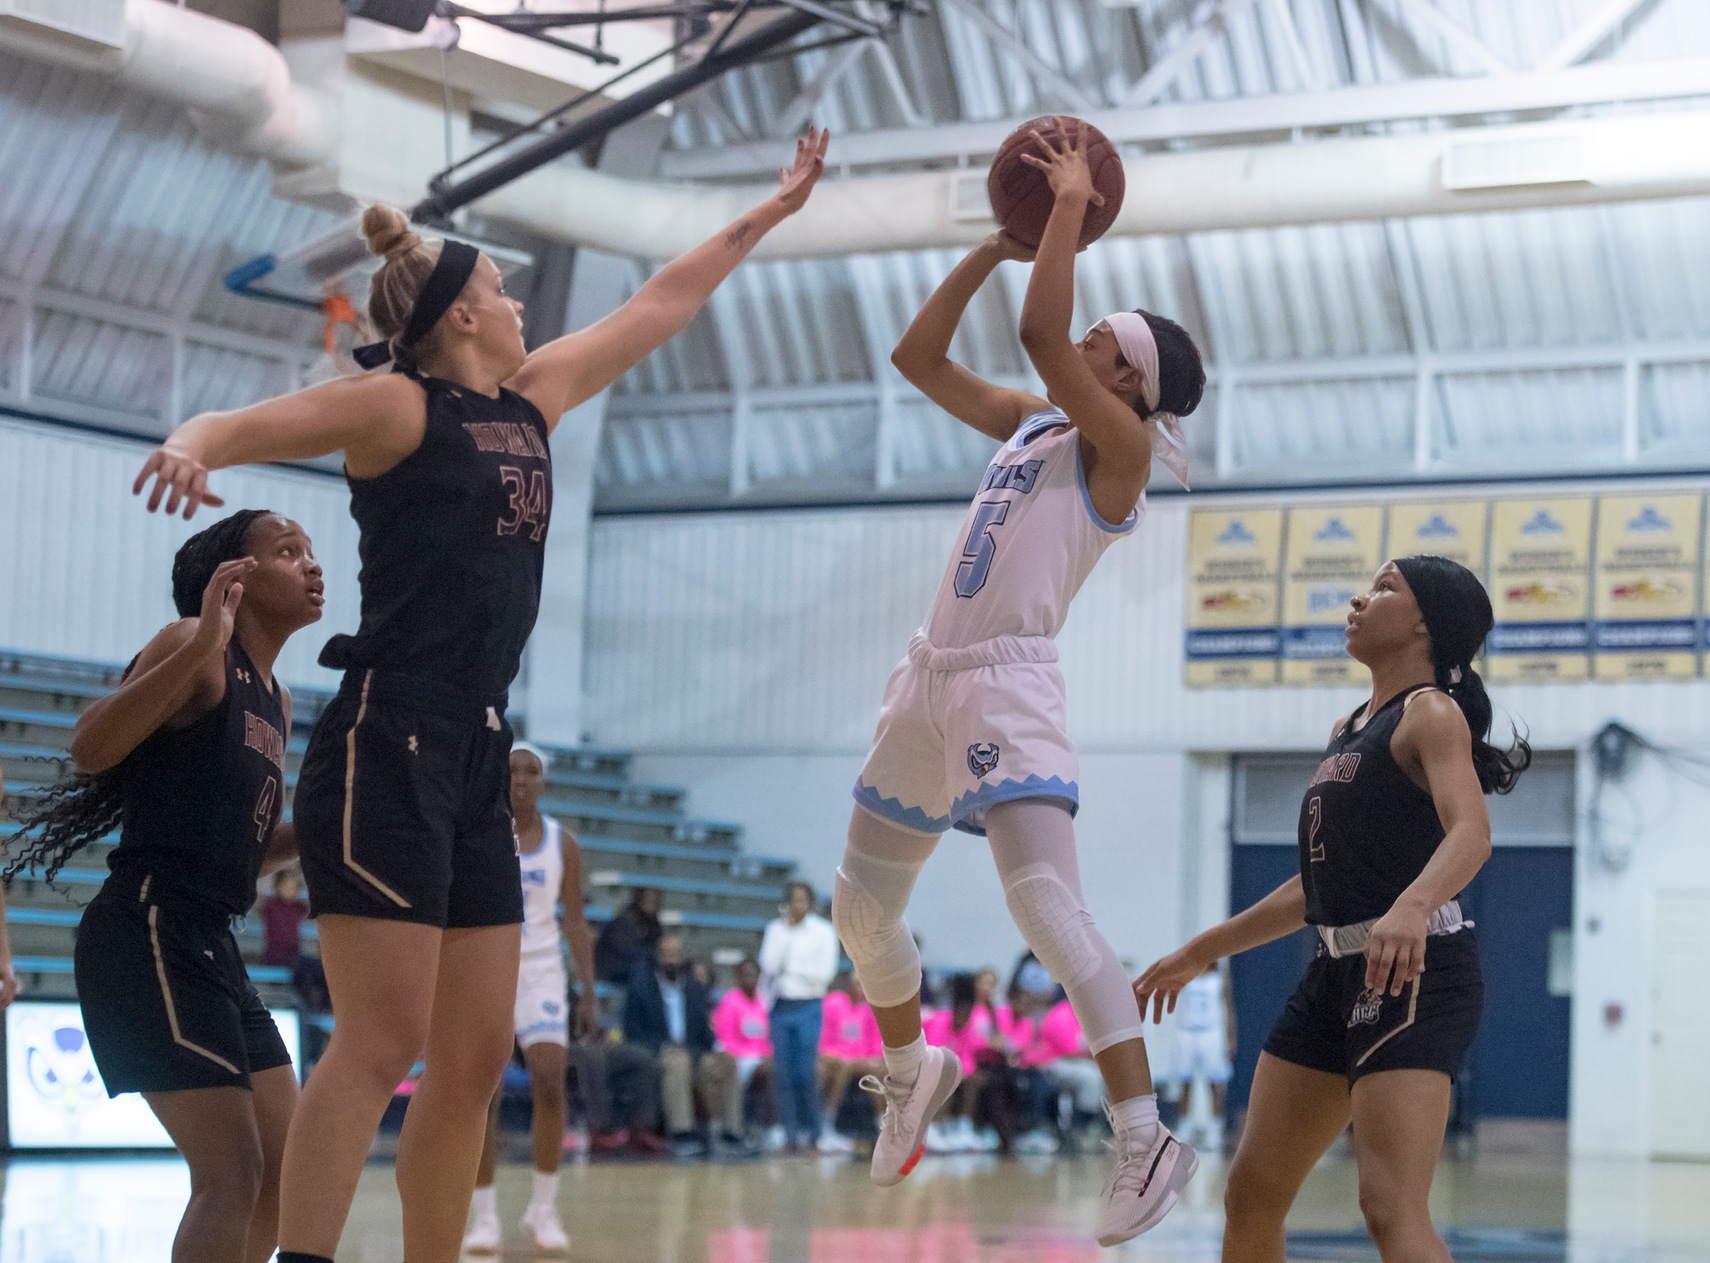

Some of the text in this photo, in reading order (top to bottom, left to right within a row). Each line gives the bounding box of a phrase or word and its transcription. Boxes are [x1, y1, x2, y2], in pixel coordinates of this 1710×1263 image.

[496, 465, 546, 541] 34
[953, 500, 1012, 598] 5
[254, 775, 276, 842] 4
[1308, 796, 1325, 862] 2
